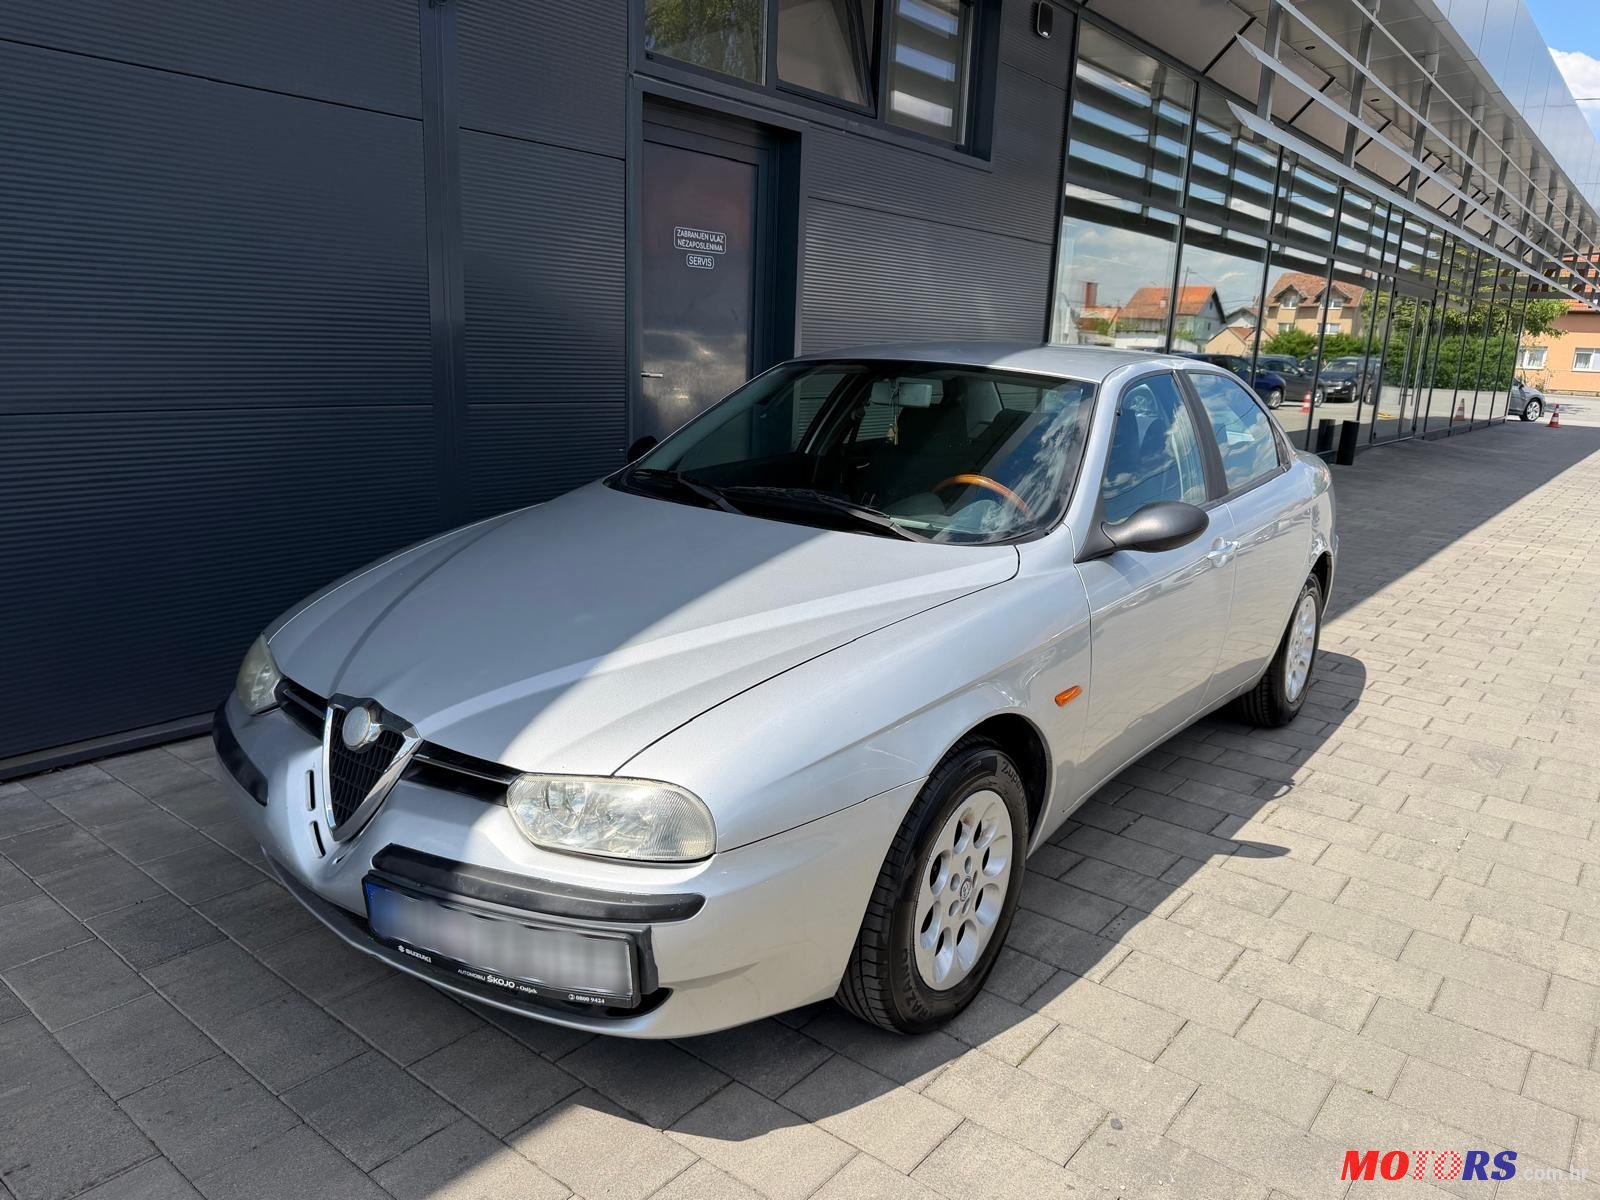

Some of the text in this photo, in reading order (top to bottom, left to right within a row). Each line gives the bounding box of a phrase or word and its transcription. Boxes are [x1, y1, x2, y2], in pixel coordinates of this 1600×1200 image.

[677, 229, 724, 244] ZABRANJEN ULAZ
[677, 239, 723, 251] NEZAPOSLENIMA
[689, 256, 712, 267] SERVIS
[405, 948, 432, 964] SUZUKI
[486, 974, 516, 989] ŠKOJO
